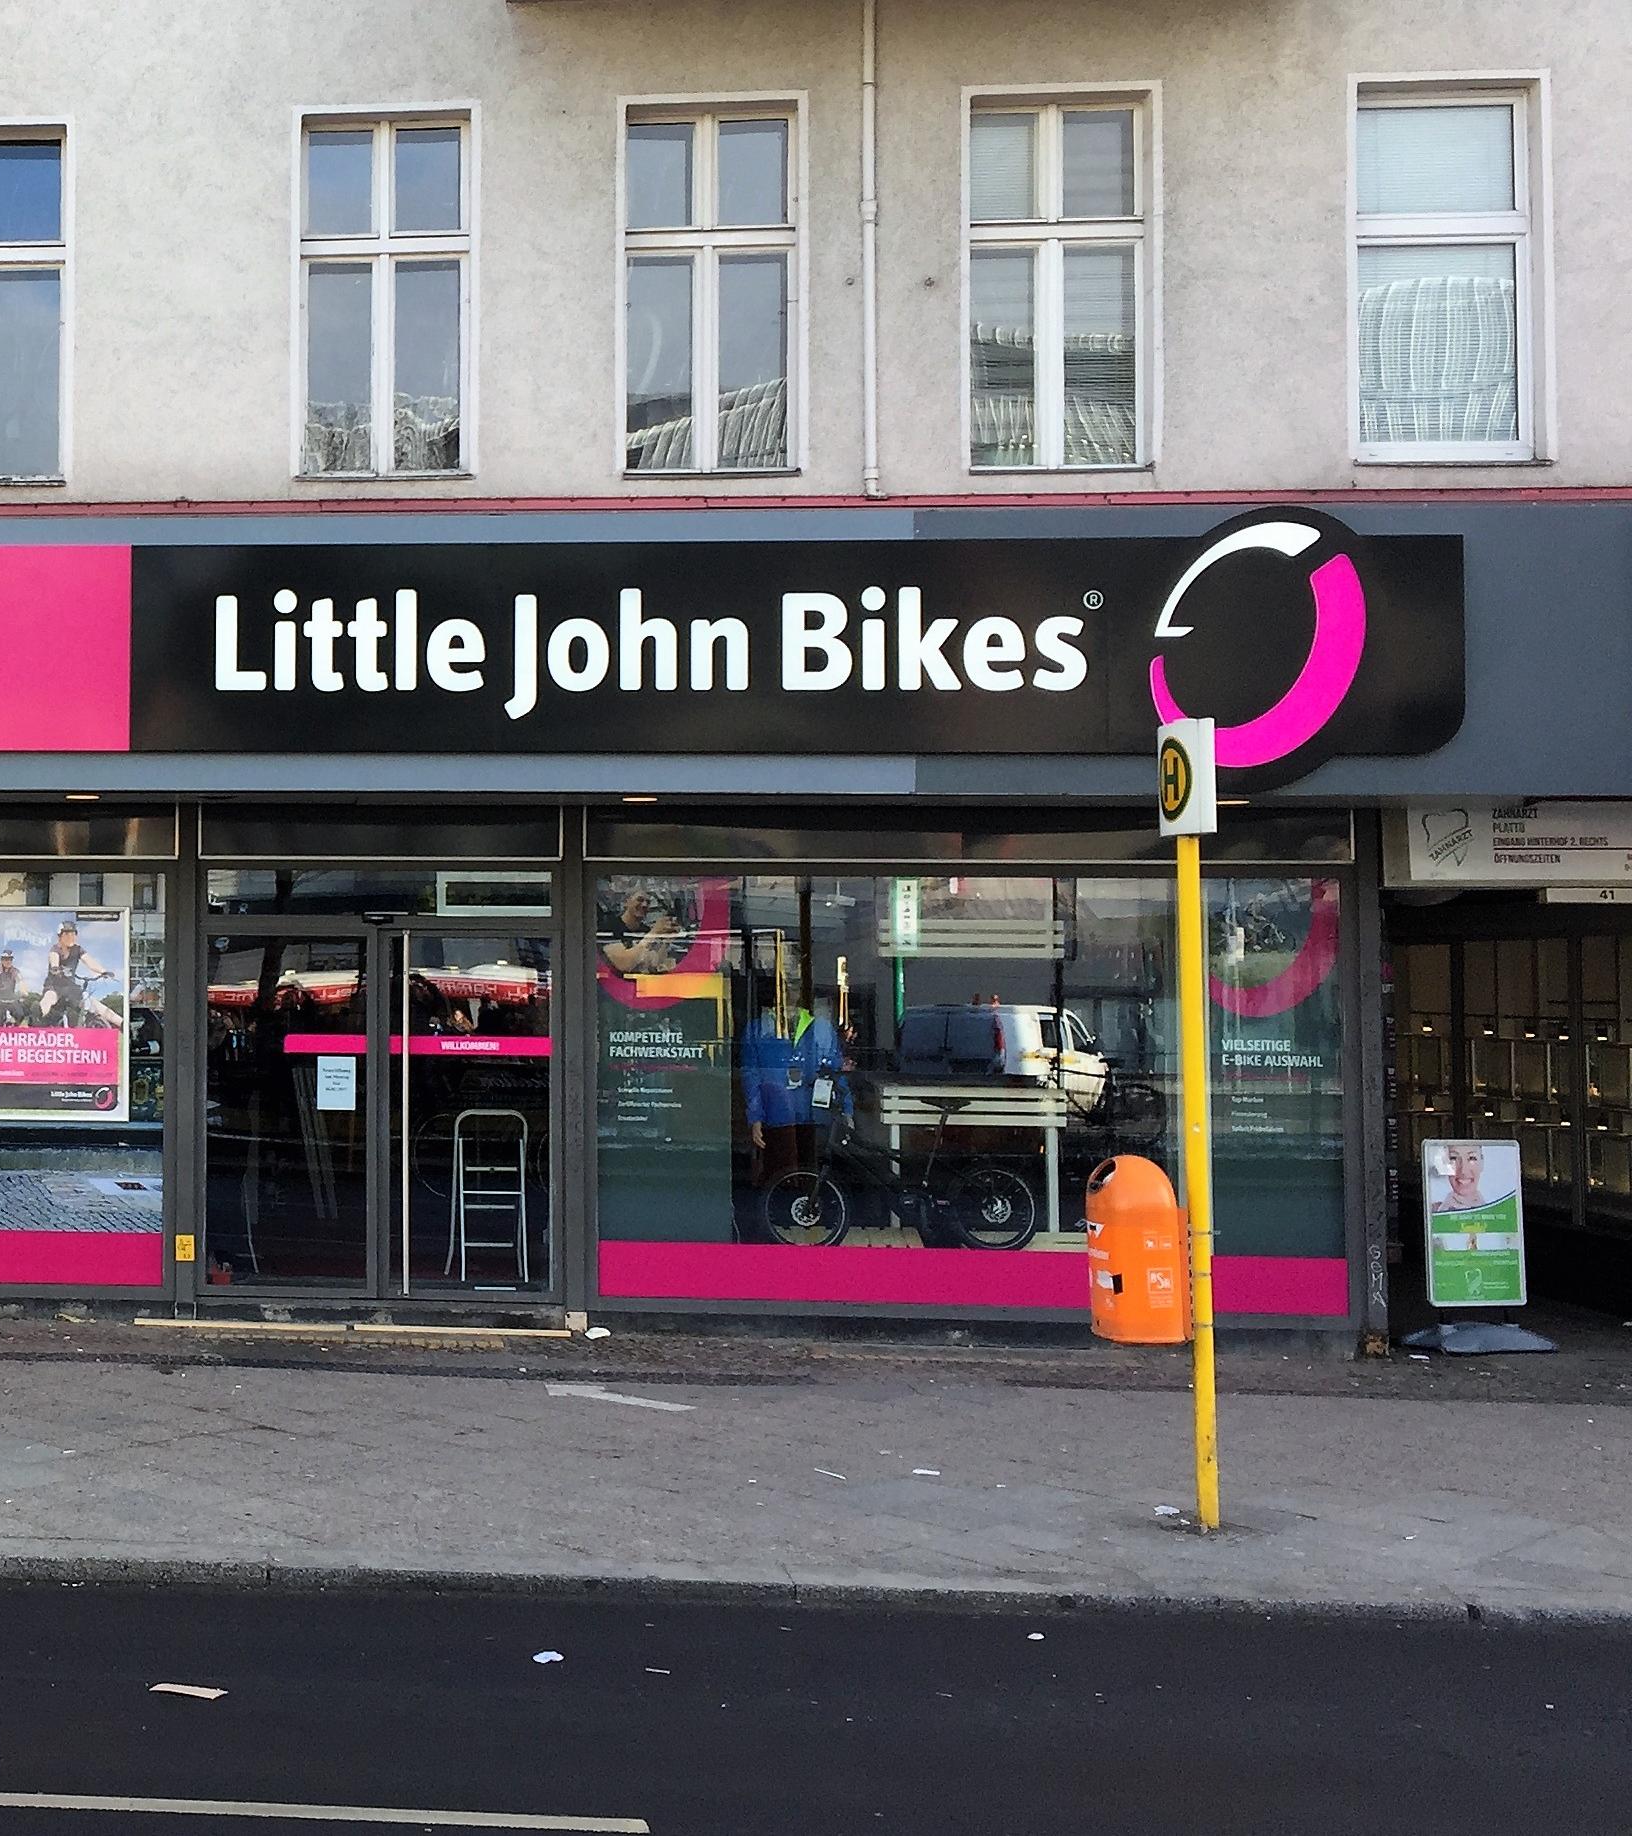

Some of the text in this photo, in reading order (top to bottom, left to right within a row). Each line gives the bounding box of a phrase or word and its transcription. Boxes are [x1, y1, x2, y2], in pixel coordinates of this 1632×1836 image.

[215, 589, 485, 691] Little
[504, 588, 749, 719] John
[1428, 828, 1474, 863] ZAHNARZT
[1600, 889, 1615, 900] 41
[609, 1031, 684, 1044] KOMPETENTE
[1222, 1039, 1291, 1052] VIELSEITIGE
[609, 1046, 704, 1059] FACHWERKSTATT
[1222, 1054, 1324, 1068] E-BIKE AUSWAHL
